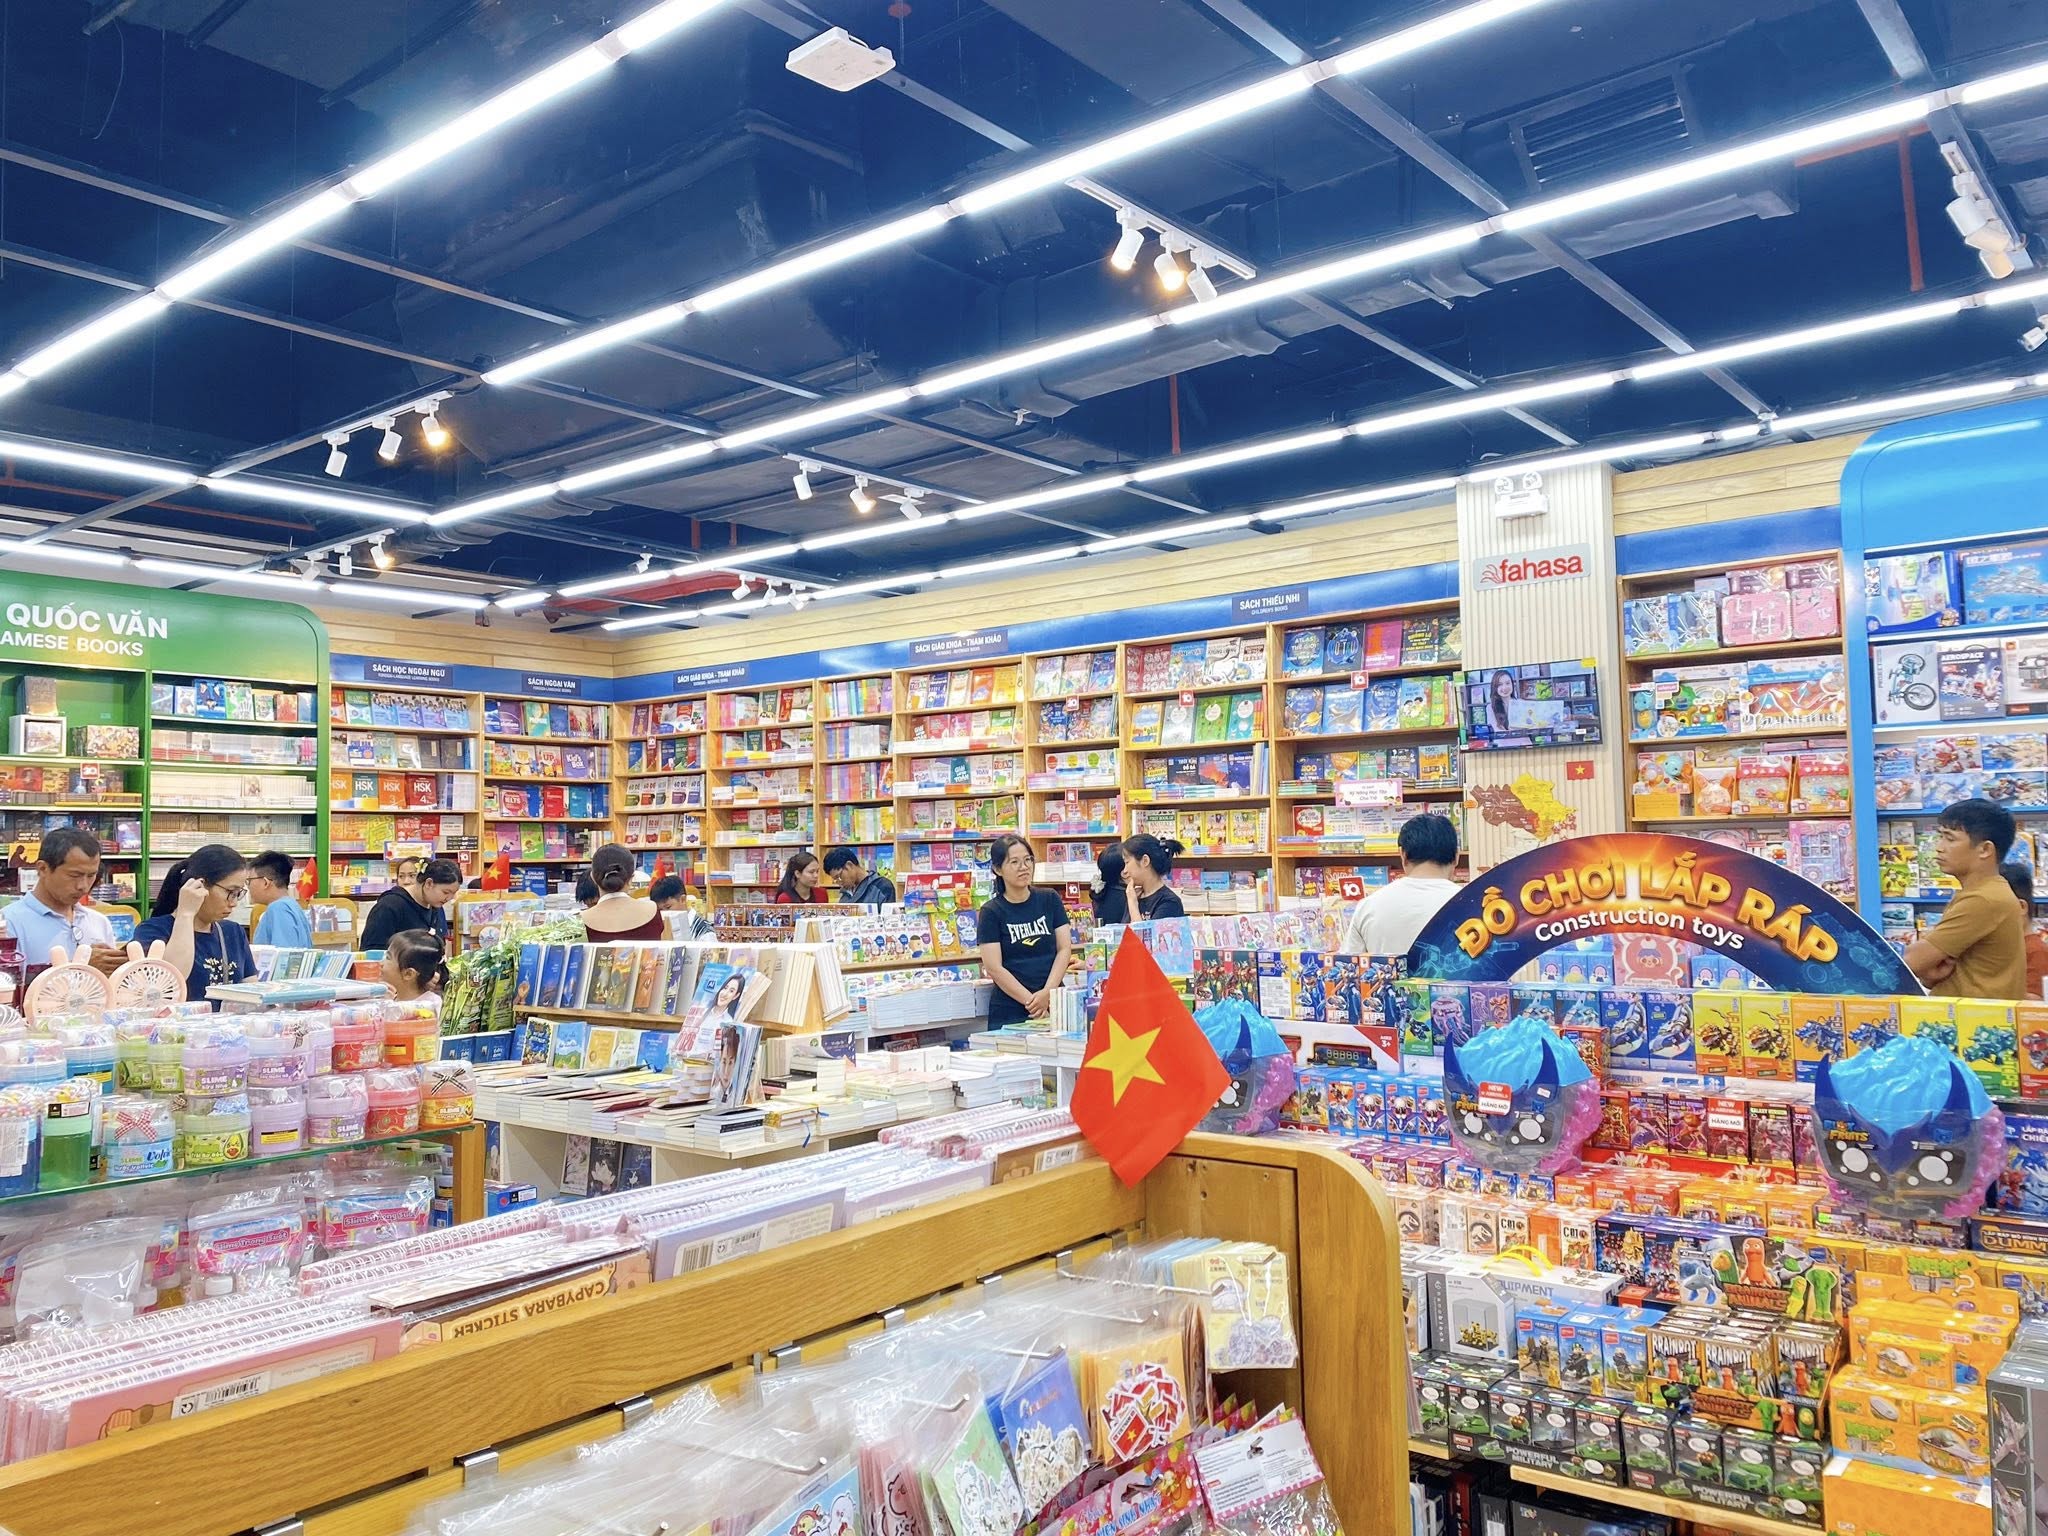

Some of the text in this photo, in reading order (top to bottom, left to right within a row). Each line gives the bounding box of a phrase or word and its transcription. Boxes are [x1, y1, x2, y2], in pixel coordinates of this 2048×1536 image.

[1499, 554, 1584, 583] fahasa
[1239, 593, 1300, 611] SÁCH THIẾU NHI
[1274, 605, 1289, 614] BOOKS
[6, 602, 169, 639] QUỐC VĂN
[76, 636, 144, 657] BOOKS
[914, 643, 931, 654] SÁCH
[931, 641, 946, 652] GIÁO
[946, 640, 962, 651] KHOA
[966, 637, 984, 647] THAM
[985, 634, 1002, 645] KHẢO
[1941, 652, 1984, 661] AEROSPACE
[372, 663, 446, 678] SÁCH HỌC NGOẠI NGỮ
[677, 674, 690, 684] SÁCH
[701, 671, 715, 681] KHOA
[717, 669, 732, 678] THAM
[527, 677, 544, 686] SÁCH
[563, 680, 576, 689] VĂN
[566, 754, 582, 763] Kid's
[571, 761, 585, 769] Box
[355, 780, 374, 791] HSK
[383, 782, 401, 792] HSK
[413, 782, 432, 793] HSK
[1068, 886, 1079, 894] 10
[1342, 883, 1362, 897] 10
[1073, 907, 1092, 918] who?
[1454, 851, 1839, 963] ĐỒ CHƠI LẮP RÁP
[1006, 915, 1052, 945] EVERLAST
[1535, 907, 1745, 950] Construction toys
[262, 1066, 286, 1075] SLIME
[201, 1075, 228, 1085] SLIME
[1708, 1078, 1720, 1088] 3+
[1488, 1084, 1504, 1092] NEW
[1711, 1117, 1742, 1126] HÀNG MỚI
[1828, 1130, 1870, 1142] FRUITS
[1983, 1235, 2047, 1252] DUMM
[1499, 1280, 1553, 1298] QUIPMENT
[453, 1281, 606, 1339] CAPYBARA STICKER
[1652, 1334, 1698, 1357] BRAINROT
[1777, 1336, 1826, 1365] BRAINROT
[1705, 1343, 1753, 1371] BRAINROT
[1505, 1445, 1560, 1465] POWERFUL
[1511, 1455, 1553, 1469] MILITARY
[1692, 1484, 1754, 1505] POWERFUL
[1699, 1494, 1749, 1510] MILITARY
